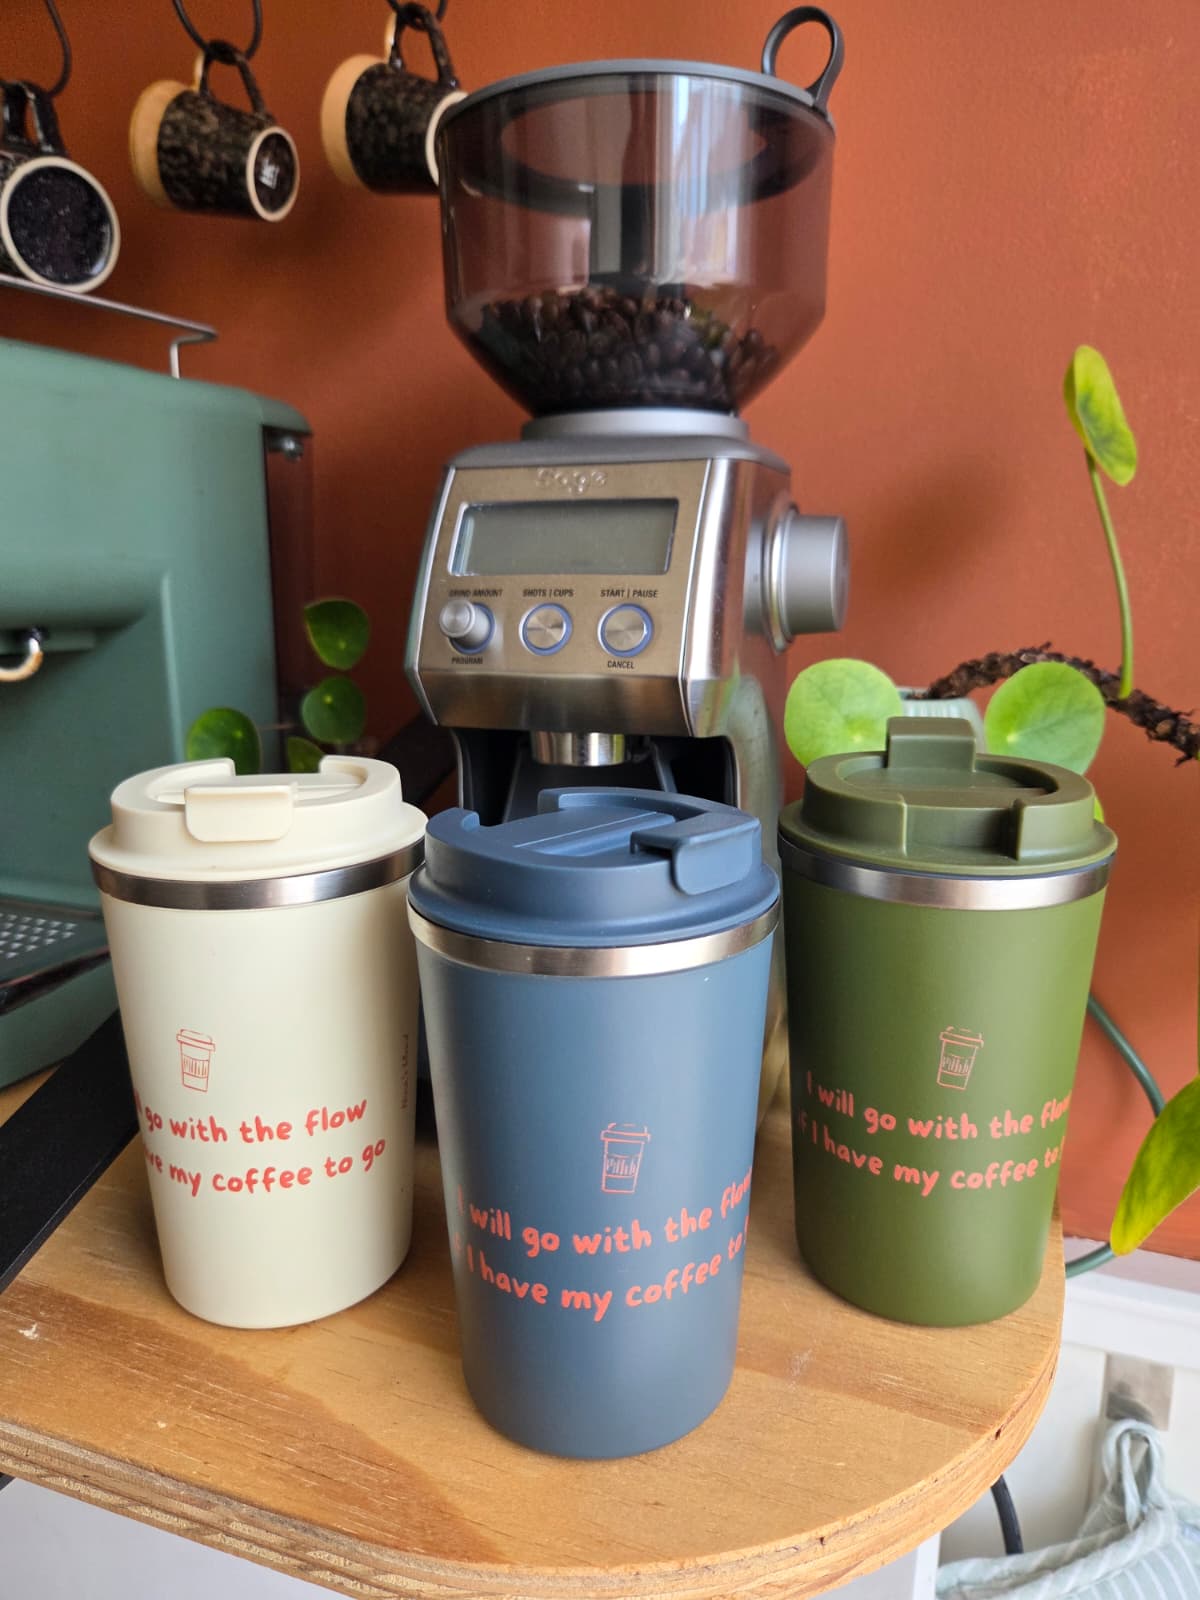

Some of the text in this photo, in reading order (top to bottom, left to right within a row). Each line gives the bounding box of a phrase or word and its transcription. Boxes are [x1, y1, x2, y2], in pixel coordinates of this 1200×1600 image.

[522, 588, 547, 598] SHOTS
[553, 588, 574, 598] CUPS
[600, 589, 626, 598] START
[632, 589, 659, 598] PAUSE
[607, 660, 635, 669] CANCEL
[145, 1099, 367, 1144] go with the flow
[818, 1084, 854, 1118] will
[864, 1107, 897, 1134] go
[908, 1112, 978, 1140] with
[990, 1109, 1034, 1140] the
[169, 1163, 202, 1198] my
[212, 1166, 313, 1194] coffee
[324, 1156, 353, 1178] to
[362, 1138, 386, 1172] go
[823, 1125, 883, 1175] have
[893, 1163, 940, 1197] my
[951, 1157, 1039, 1189] coffee
[1044, 1147, 1059, 1169] to
[469, 1203, 511, 1241] will
[522, 1227, 560, 1258] go
[572, 1218, 652, 1255] with
[664, 1207, 713, 1243] the
[480, 1249, 549, 1305] have
[561, 1288, 613, 1322] my
[625, 1253, 722, 1306] coffee
[728, 1232, 743, 1261] to
